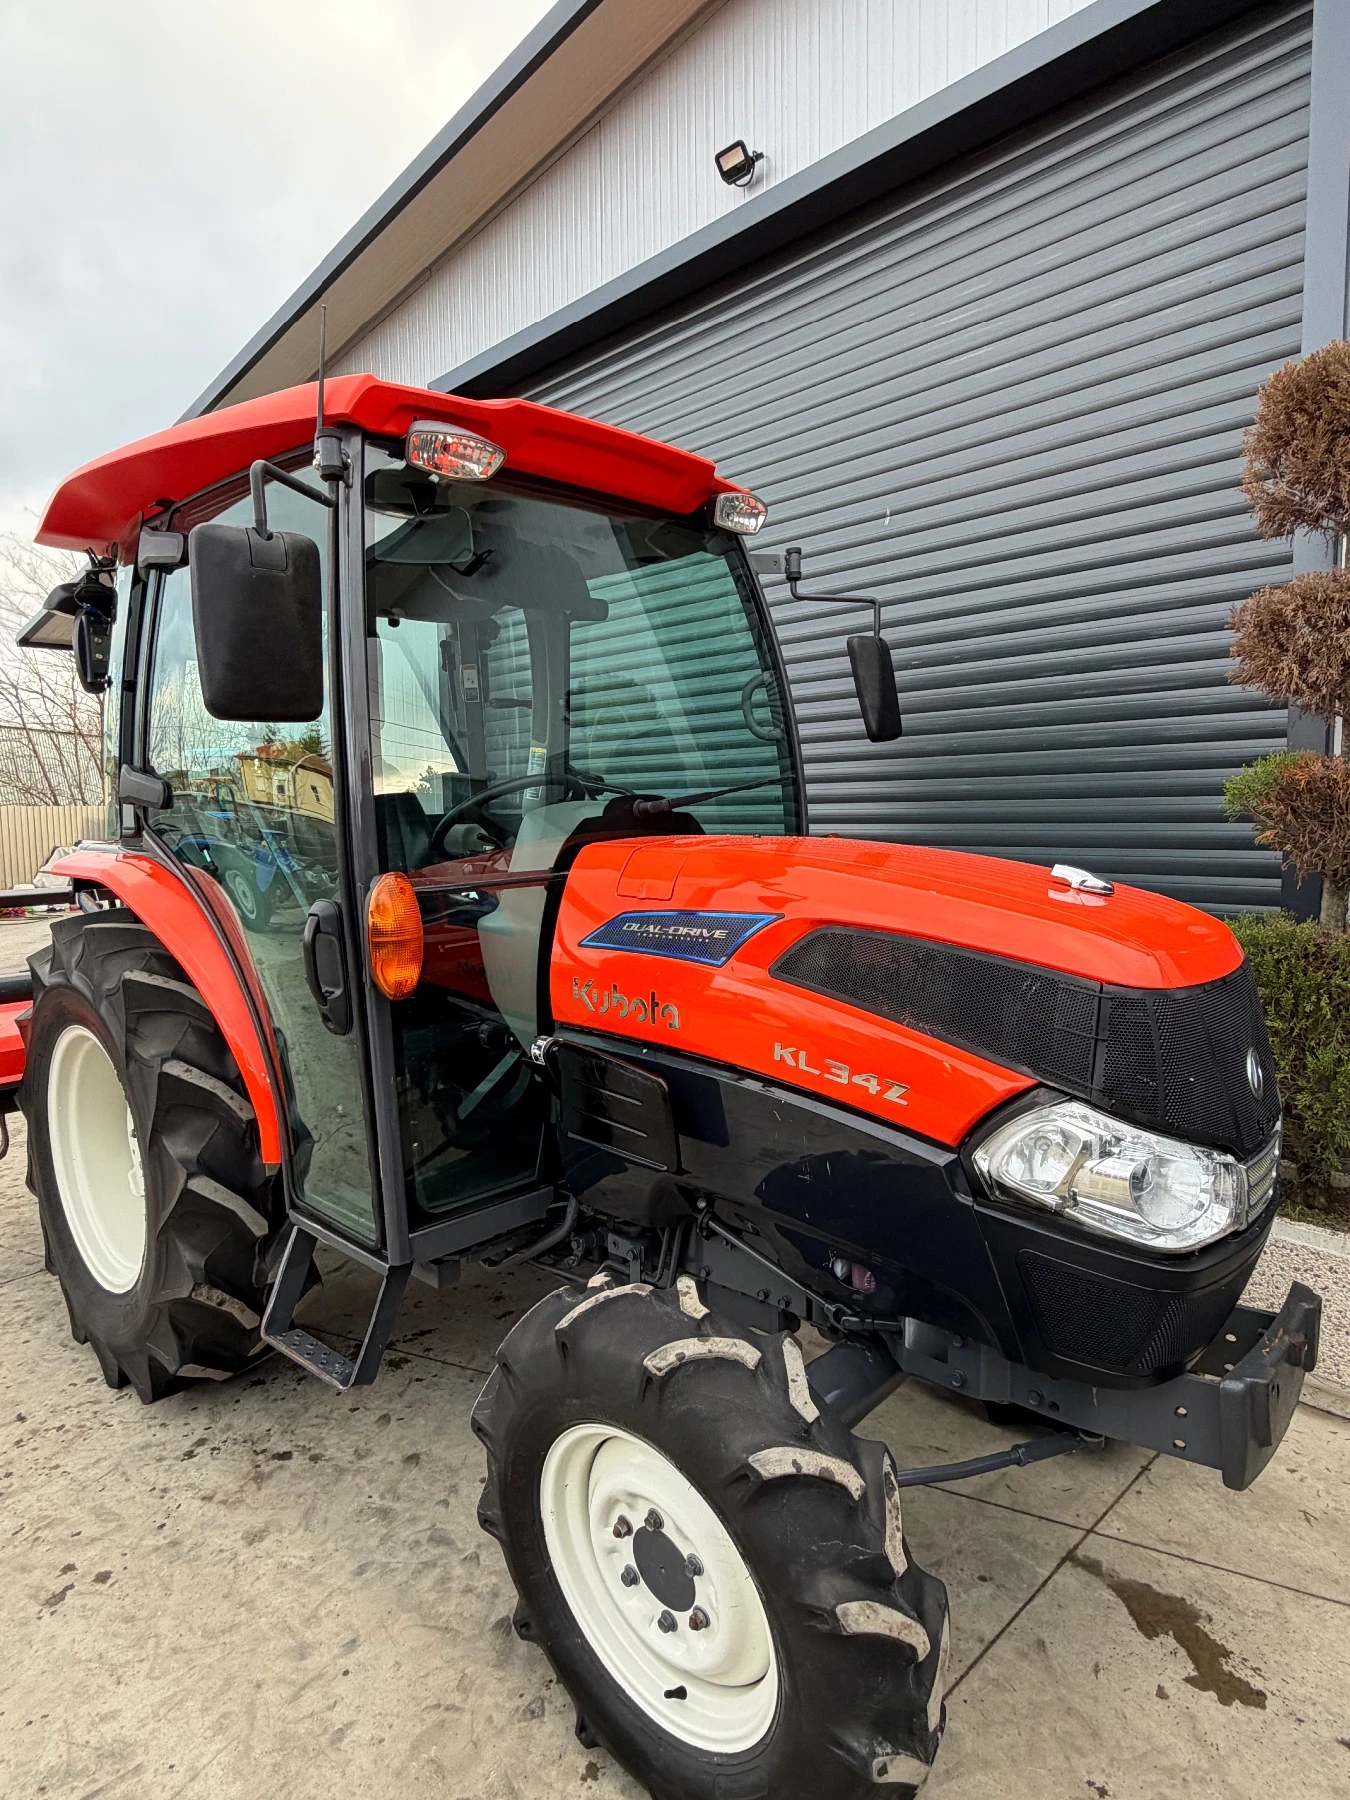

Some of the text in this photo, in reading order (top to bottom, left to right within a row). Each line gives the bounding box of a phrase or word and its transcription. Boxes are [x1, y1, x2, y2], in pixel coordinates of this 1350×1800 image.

[622, 922, 729, 939] DUAL-DRIVE
[572, 977, 680, 1030] Kubota
[773, 1042, 911, 1106] KL34Z
